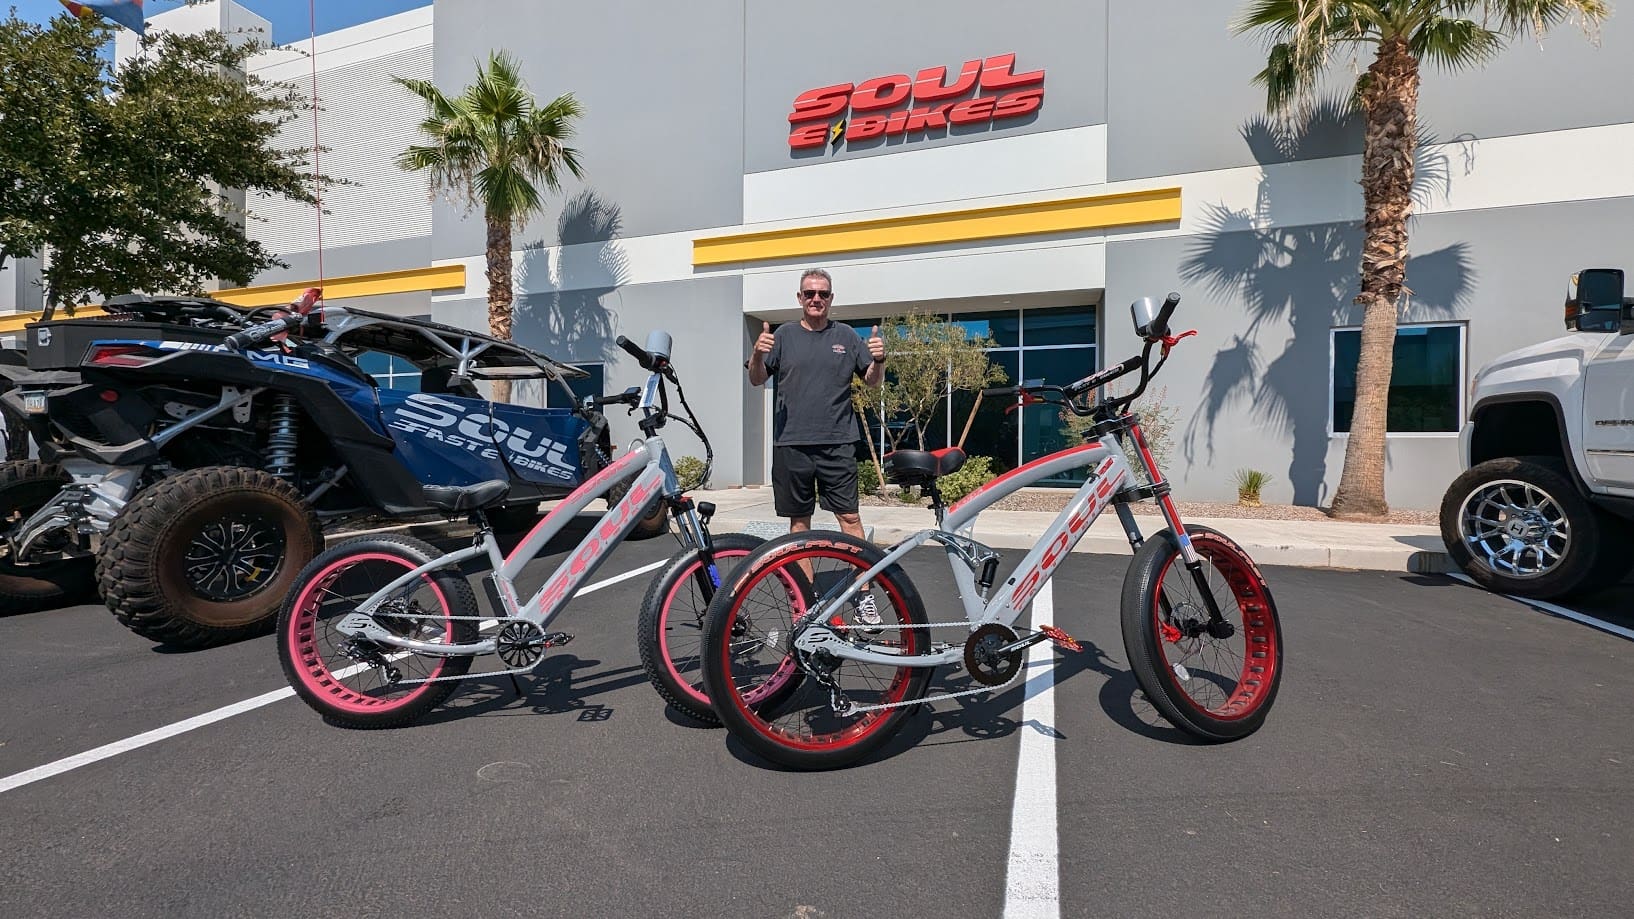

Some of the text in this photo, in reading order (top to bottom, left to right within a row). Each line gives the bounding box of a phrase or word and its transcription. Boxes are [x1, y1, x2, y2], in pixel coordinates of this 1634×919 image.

[788, 53, 1045, 123] SOUL
[391, 419, 484, 450] FAST
[513, 455, 573, 480] BIKES
[395, 393, 577, 471] SOUL
[538, 475, 661, 614] SOUL
[1012, 468, 1125, 611] SOUL
